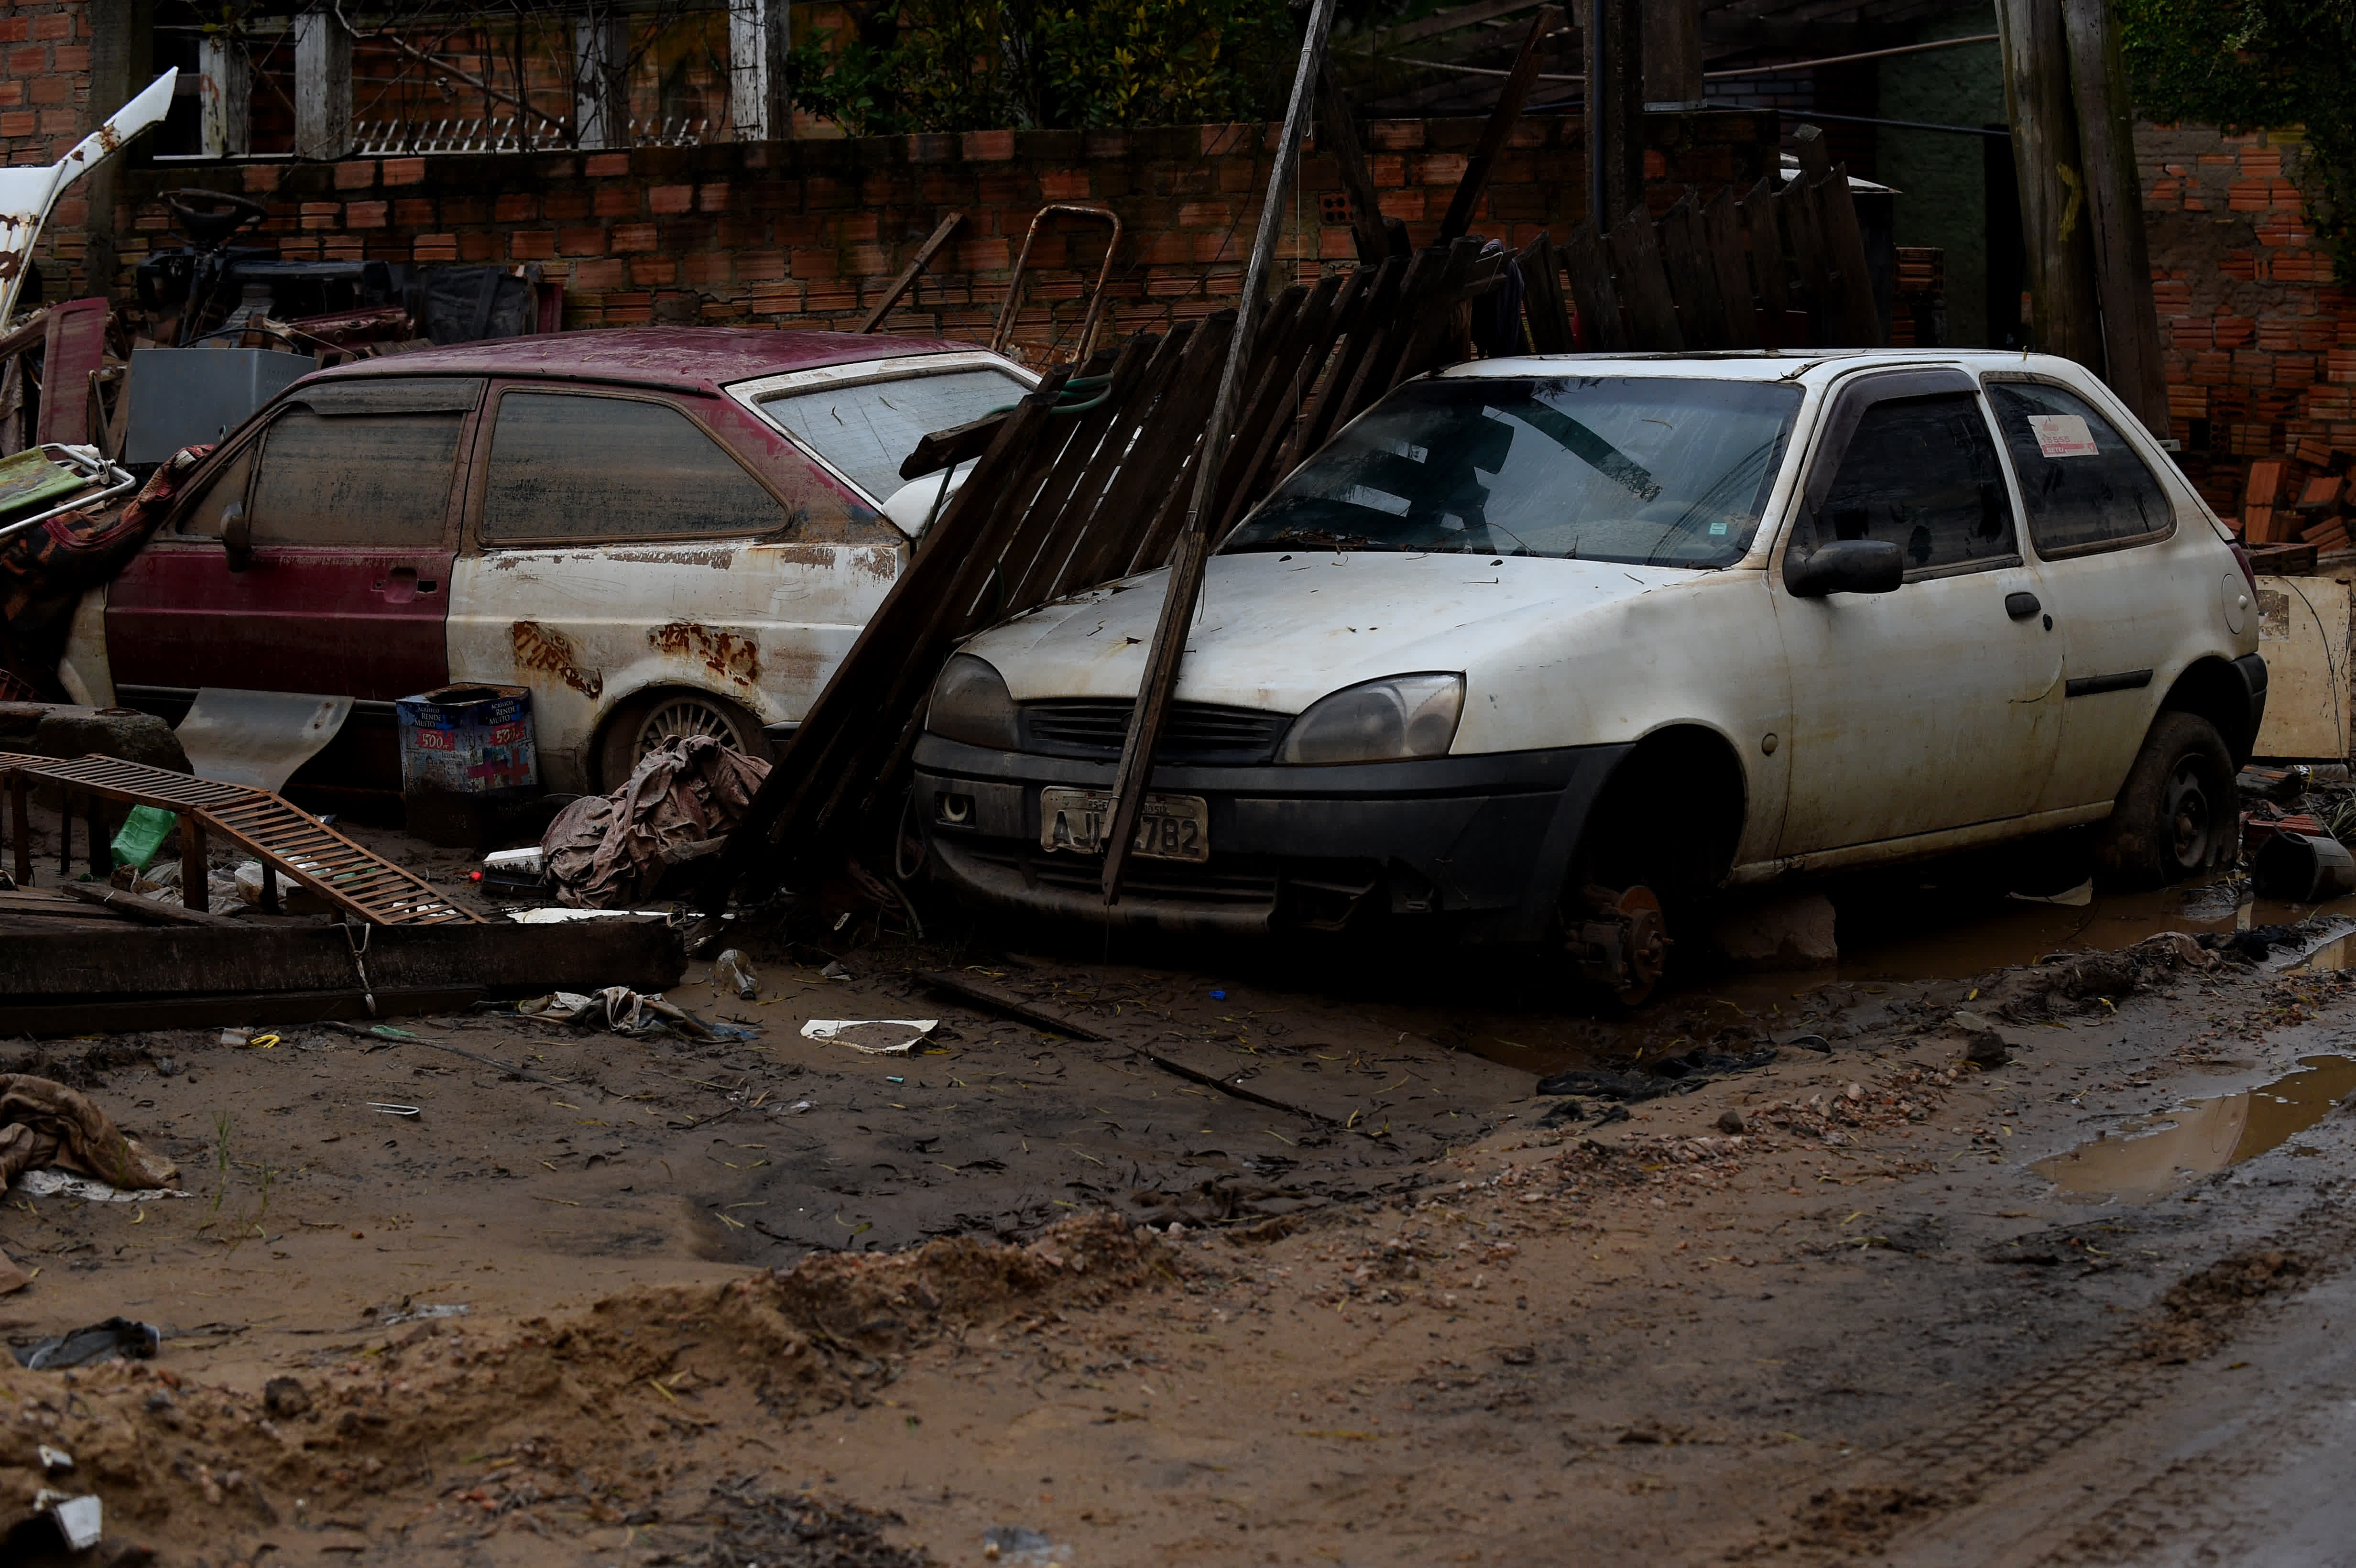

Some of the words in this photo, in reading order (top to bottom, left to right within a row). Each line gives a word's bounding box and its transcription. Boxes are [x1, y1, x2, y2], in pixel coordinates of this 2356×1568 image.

[496, 706, 516, 716] RENDE
[422, 712, 442, 721] RENDE
[490, 715, 510, 725] MUITO
[414, 719, 436, 727] MUITO
[423, 734, 443, 748] 500
